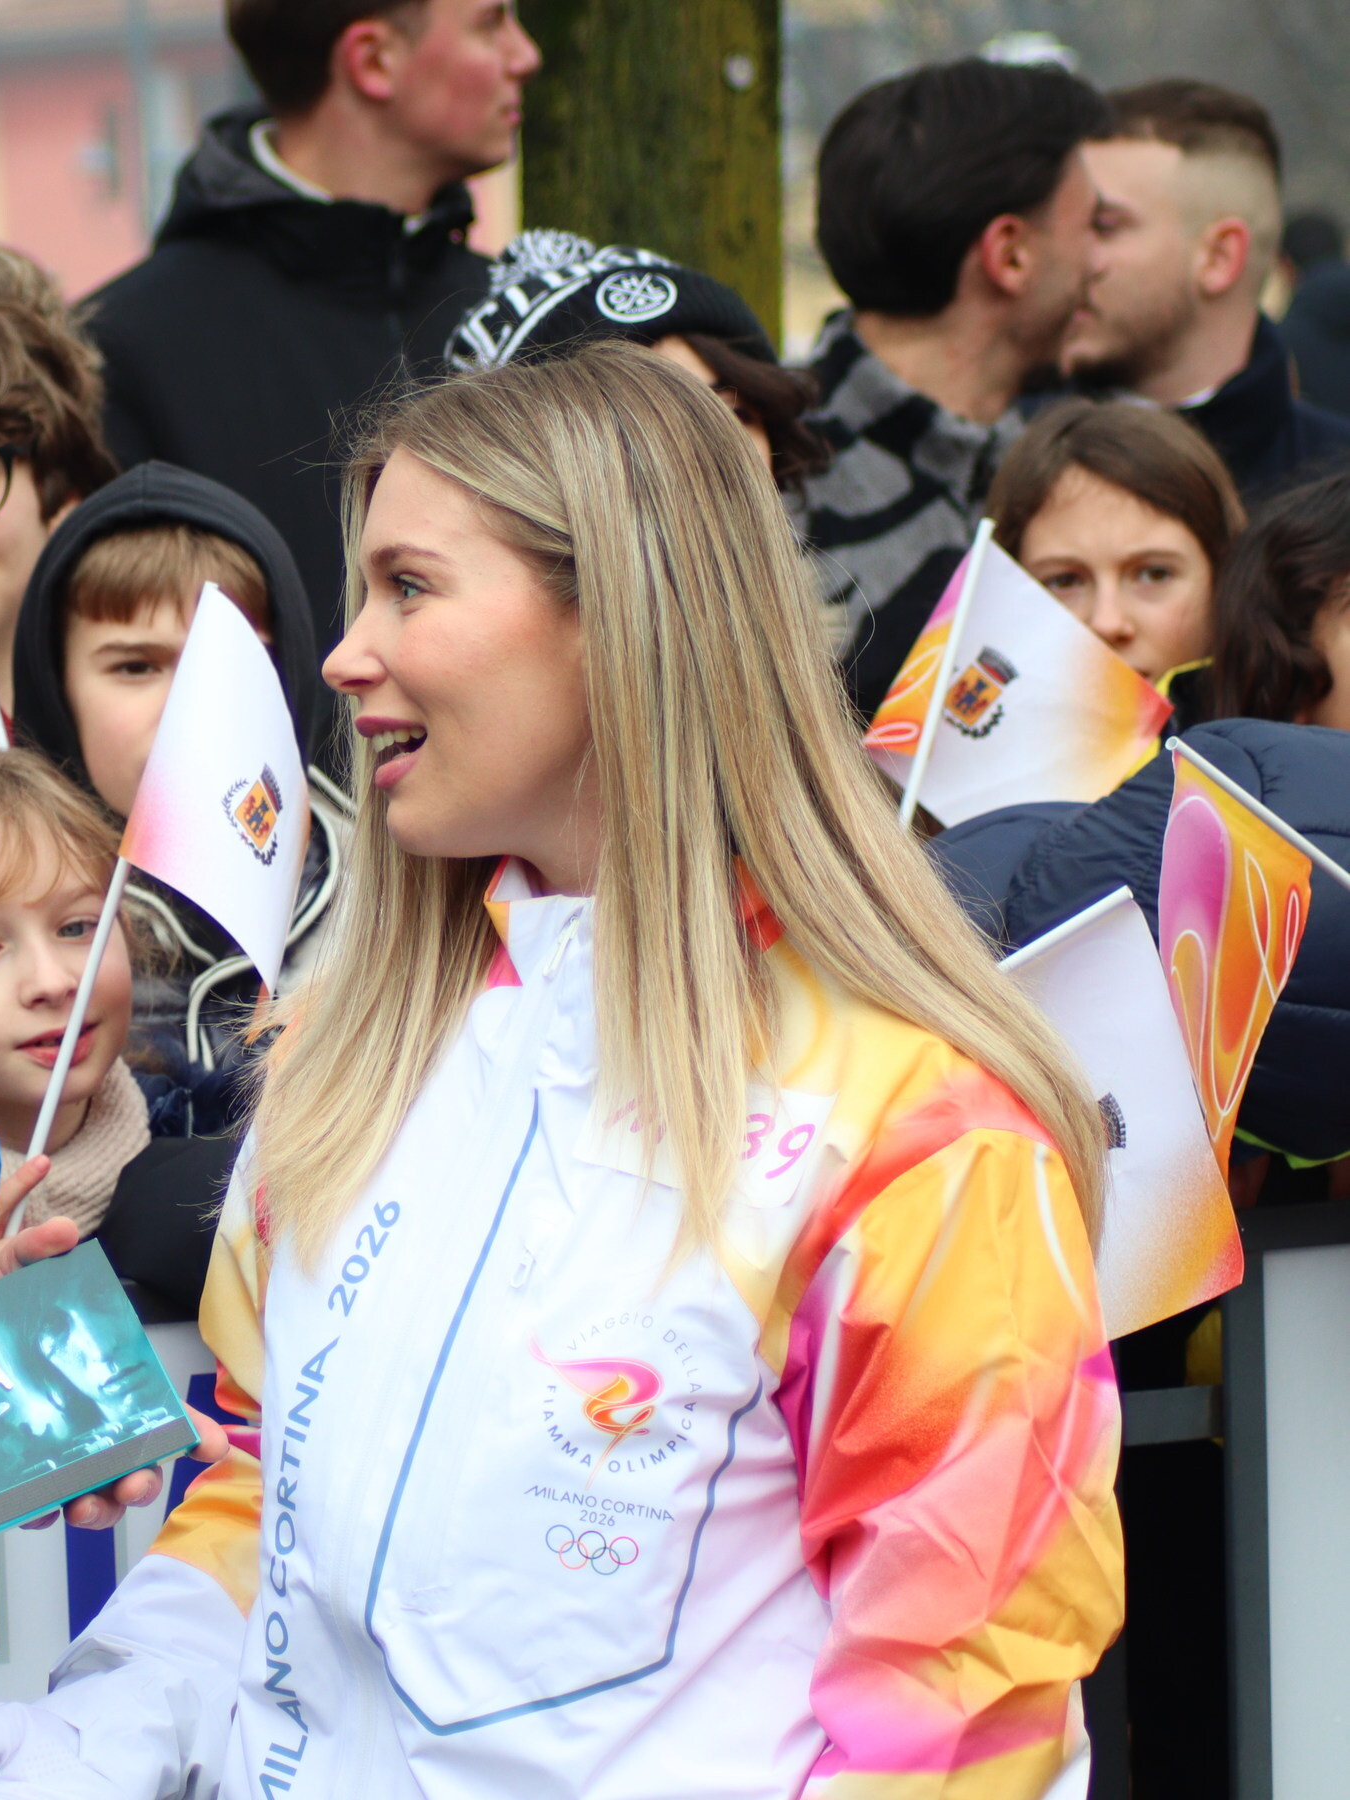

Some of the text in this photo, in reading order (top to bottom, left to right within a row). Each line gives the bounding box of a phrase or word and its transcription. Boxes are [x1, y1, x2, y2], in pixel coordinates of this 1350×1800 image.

[567, 1312, 702, 1393] VIAGGIO DELLA
[269, 1336, 341, 1598] CORTINA
[328, 1200, 401, 1318] 2026
[543, 1385, 697, 1473] FIAMMA OLIMPICA
[523, 1485, 675, 1522] MILANO CORTINA
[579, 1510, 616, 1527] 2026
